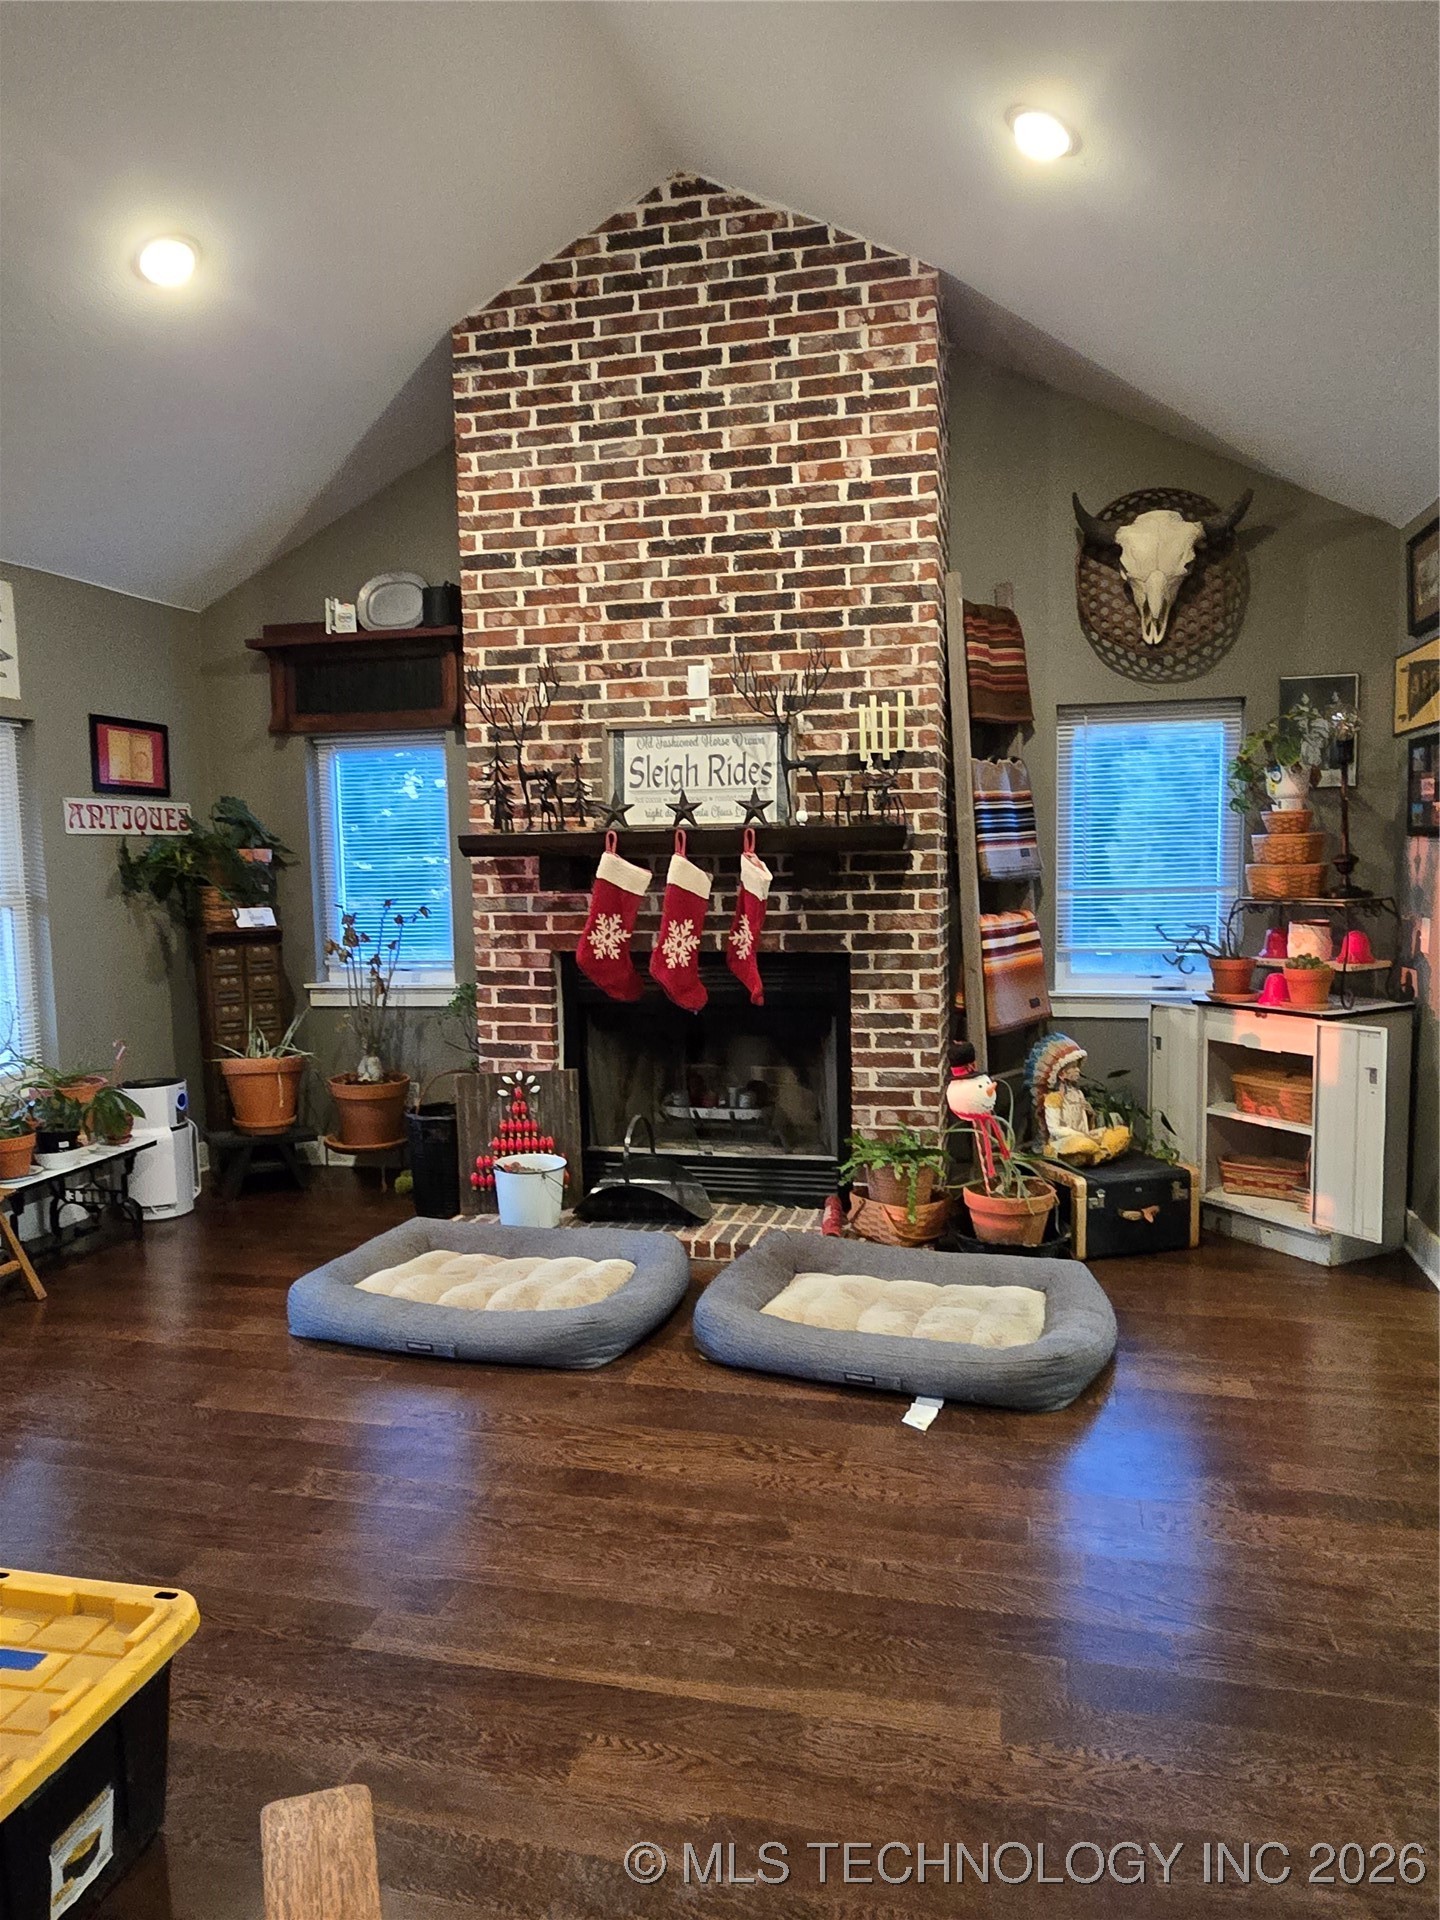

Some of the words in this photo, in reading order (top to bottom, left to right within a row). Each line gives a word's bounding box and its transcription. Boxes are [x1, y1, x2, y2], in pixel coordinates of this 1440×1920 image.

[701, 733, 730, 747] Horse
[629, 753, 699, 795] Sleigh
[708, 752, 773, 787] Rides
[68, 802, 190, 832] ANTIQUES
